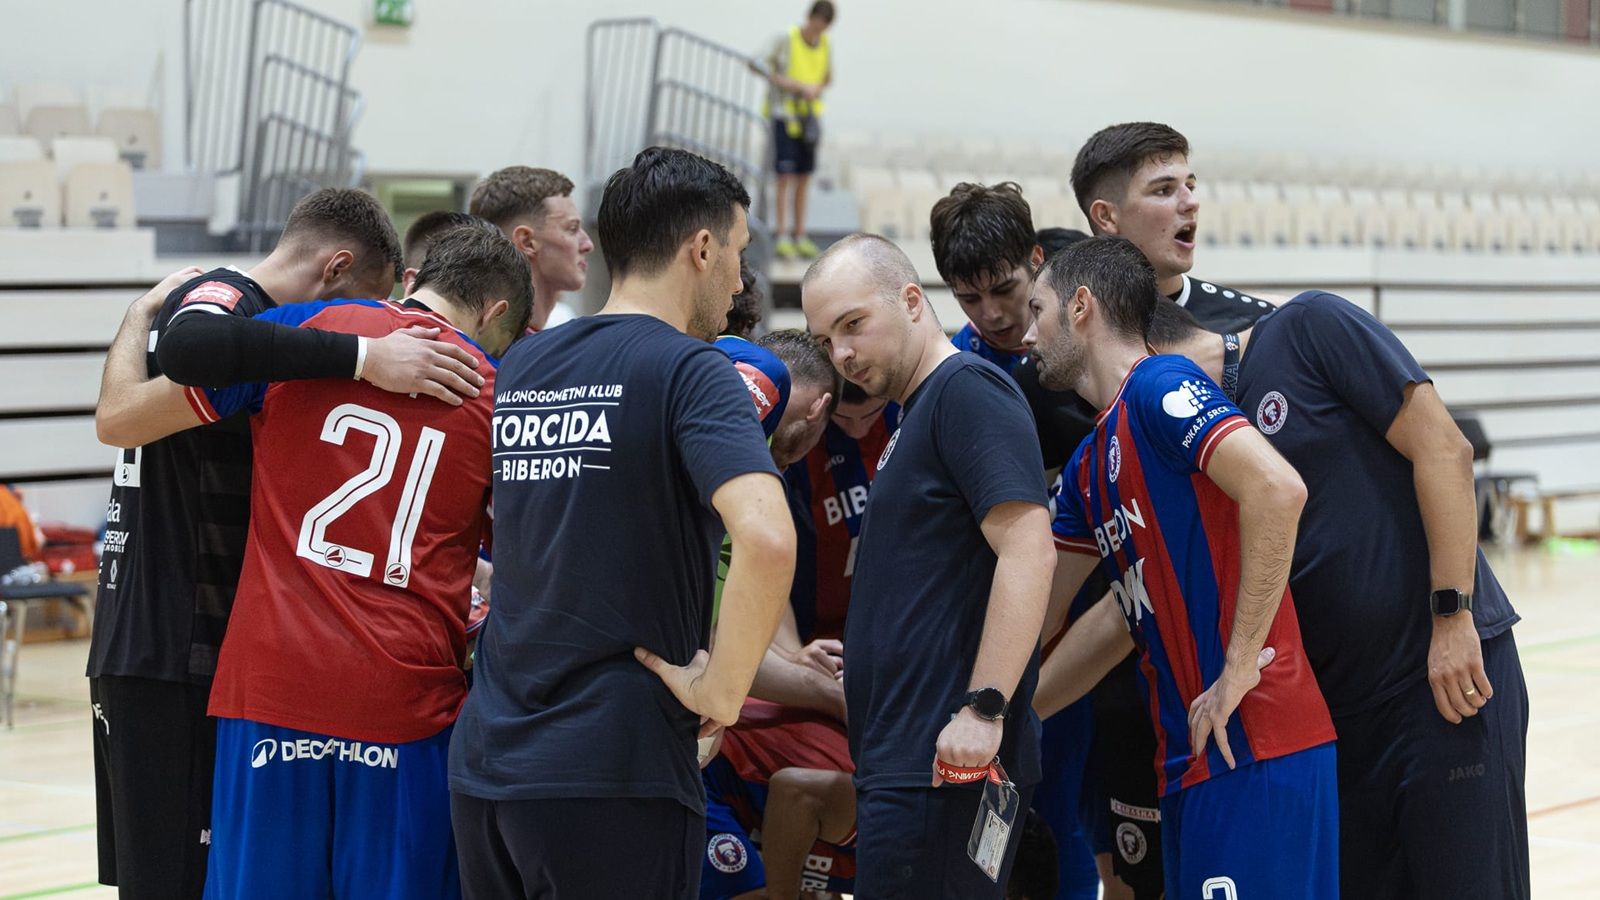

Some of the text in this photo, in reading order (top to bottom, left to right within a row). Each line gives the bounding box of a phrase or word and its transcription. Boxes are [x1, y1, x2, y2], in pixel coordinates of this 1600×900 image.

[588, 384, 623, 397] KLUB
[492, 409, 611, 449] TORCIDA
[1182, 405, 1231, 449] POKAŽI SRCE
[502, 455, 581, 481] BIBERON
[296, 403, 446, 588] 21
[823, 481, 871, 526] BIB
[801, 854, 833, 895] BIB
